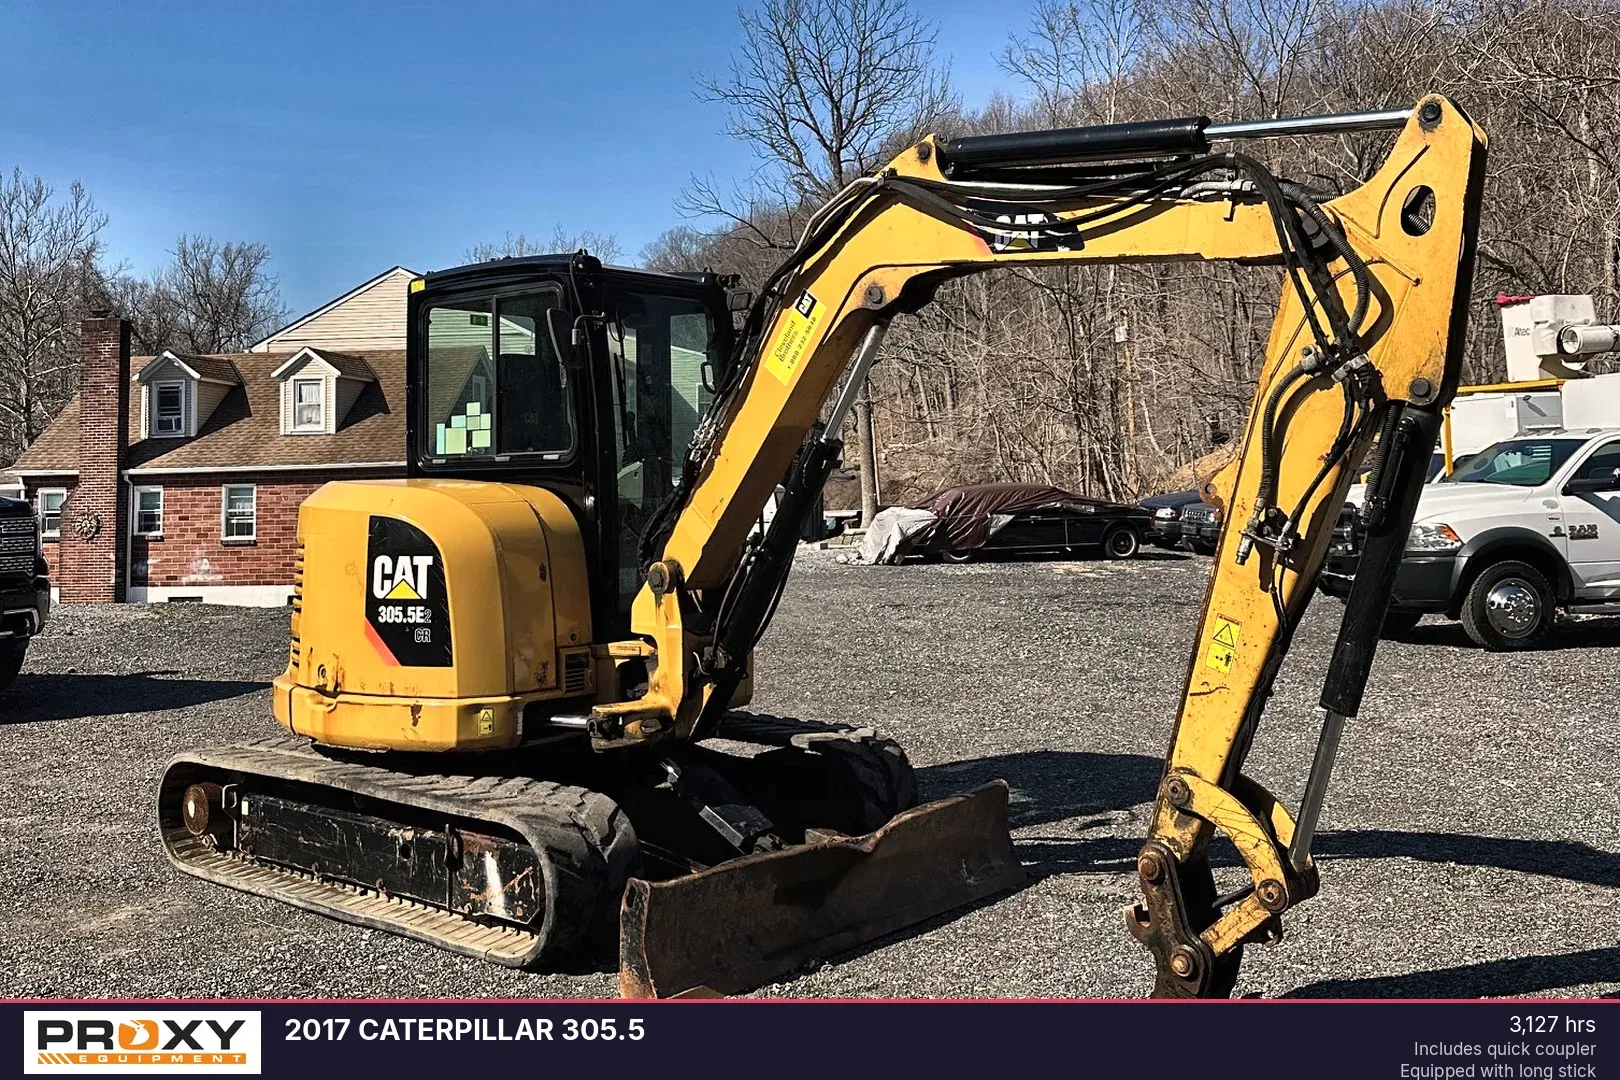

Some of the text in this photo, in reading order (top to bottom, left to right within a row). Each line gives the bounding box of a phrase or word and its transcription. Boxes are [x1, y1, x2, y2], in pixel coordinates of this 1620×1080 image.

[994, 213, 1045, 251] CAT
[798, 293, 813, 315] CAT
[774, 319, 796, 358] Cleveland
[778, 330, 799, 363] Brothers
[373, 554, 434, 600] CAT
[378, 605, 432, 624] 305.5E2
[414, 628, 432, 643] CR
